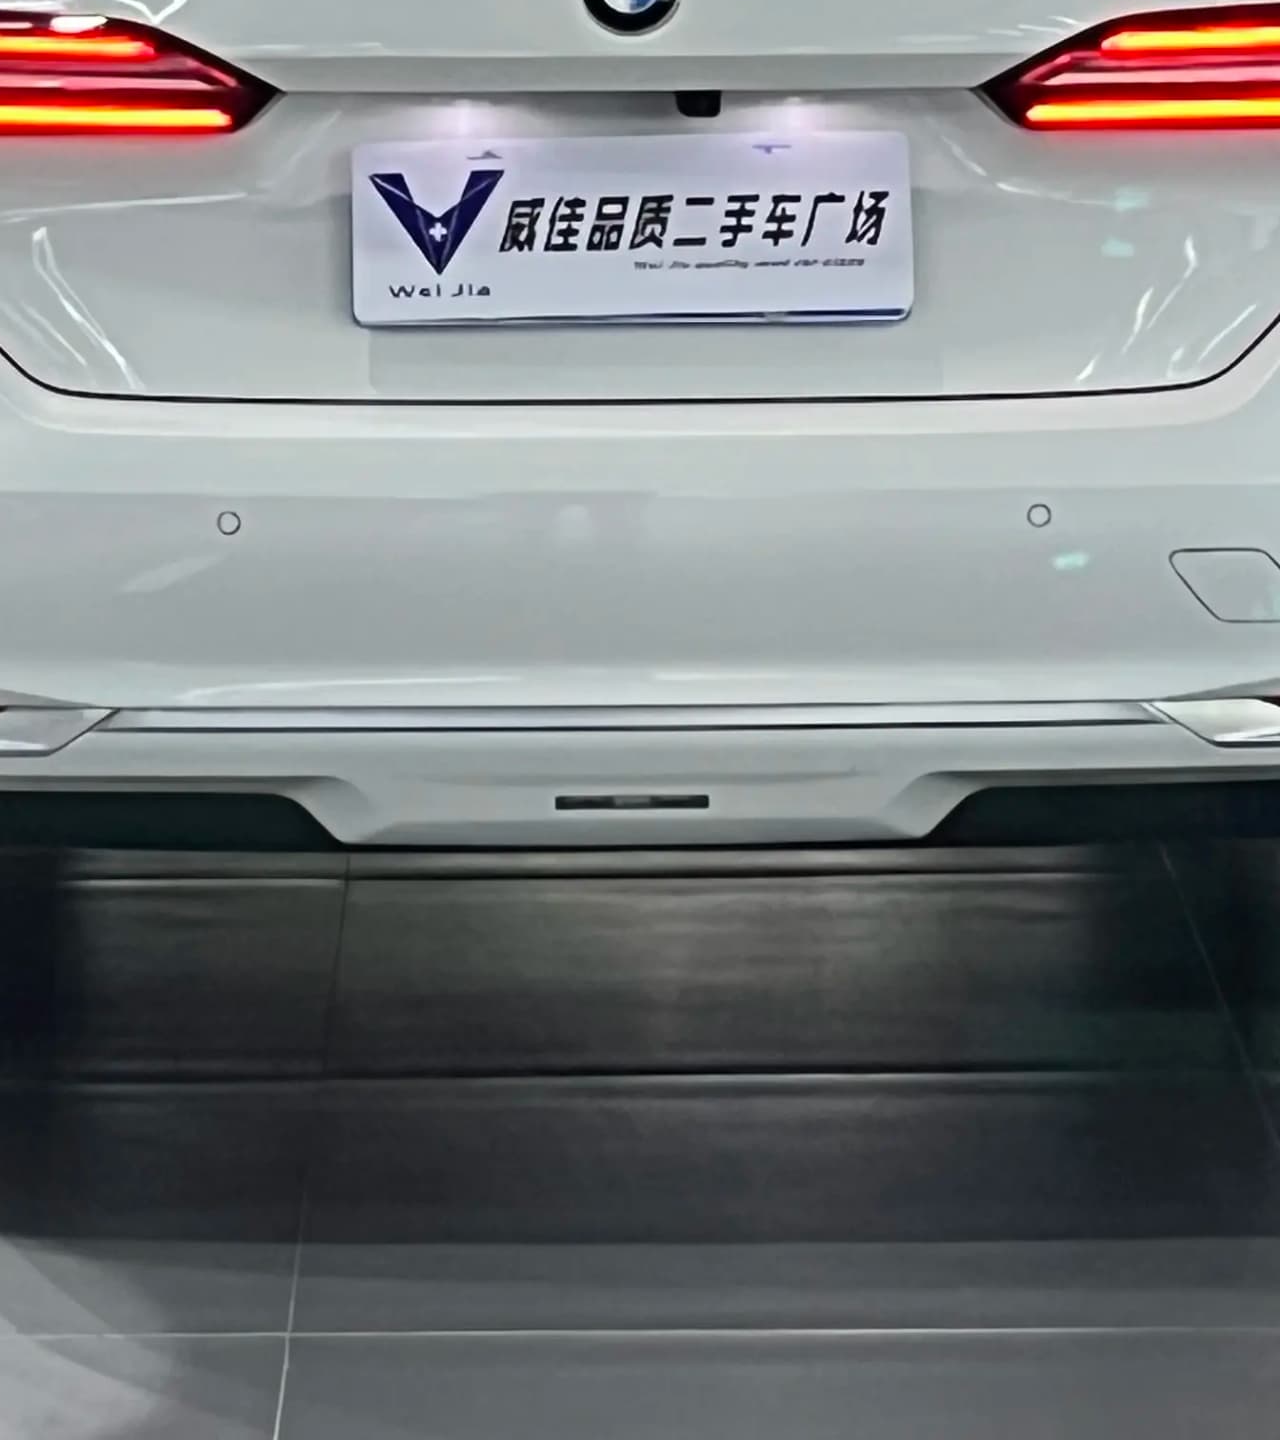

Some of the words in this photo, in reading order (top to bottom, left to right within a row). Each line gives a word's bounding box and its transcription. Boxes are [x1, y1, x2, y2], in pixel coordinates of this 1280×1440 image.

[499, 190, 890, 253] 威佳品质二手车广场
